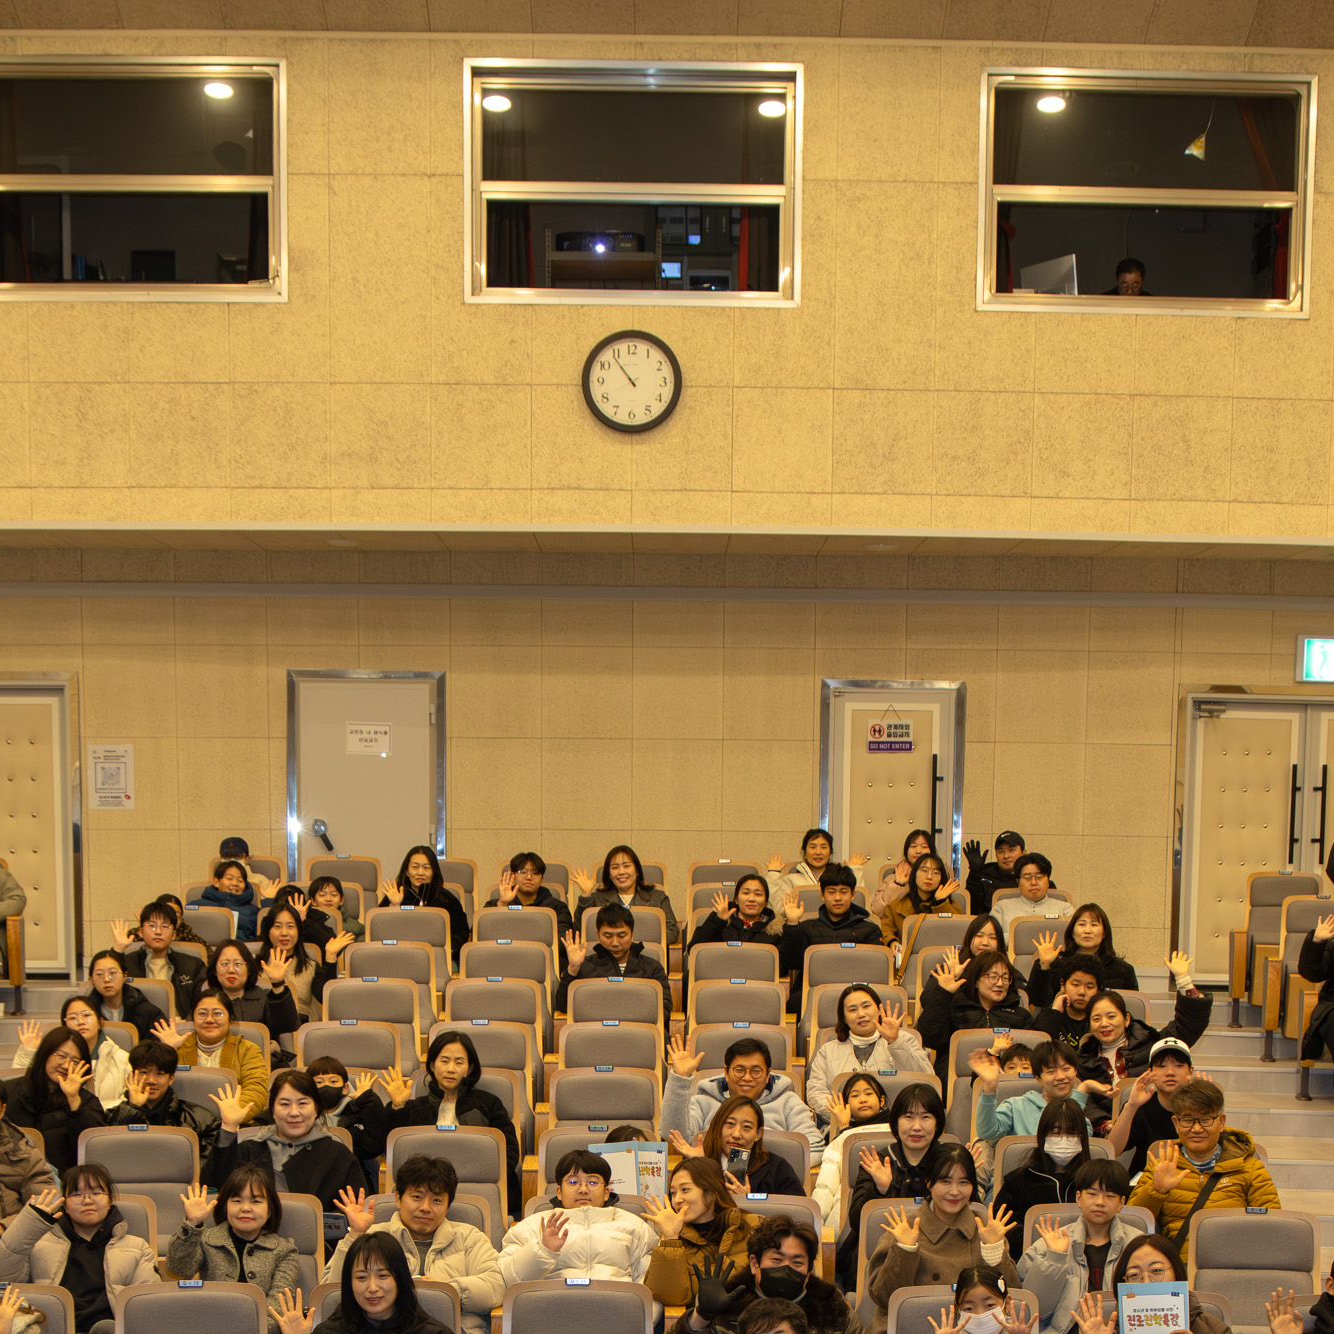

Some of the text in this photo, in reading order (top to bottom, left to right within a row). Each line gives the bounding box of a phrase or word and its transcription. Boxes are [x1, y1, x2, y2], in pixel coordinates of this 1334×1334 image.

[627, 344, 638, 355] 12
[646, 348, 650, 359] 1
[599, 360, 611, 371] 10
[656, 360, 663, 371] 2
[596, 376, 605, 388] 9
[659, 376, 667, 388] 3
[601, 392, 609, 403] 8
[654, 392, 662, 403] 4
[612, 405, 619, 416] 7
[628, 409, 636, 420] 6
[643, 405, 652, 416] 5
